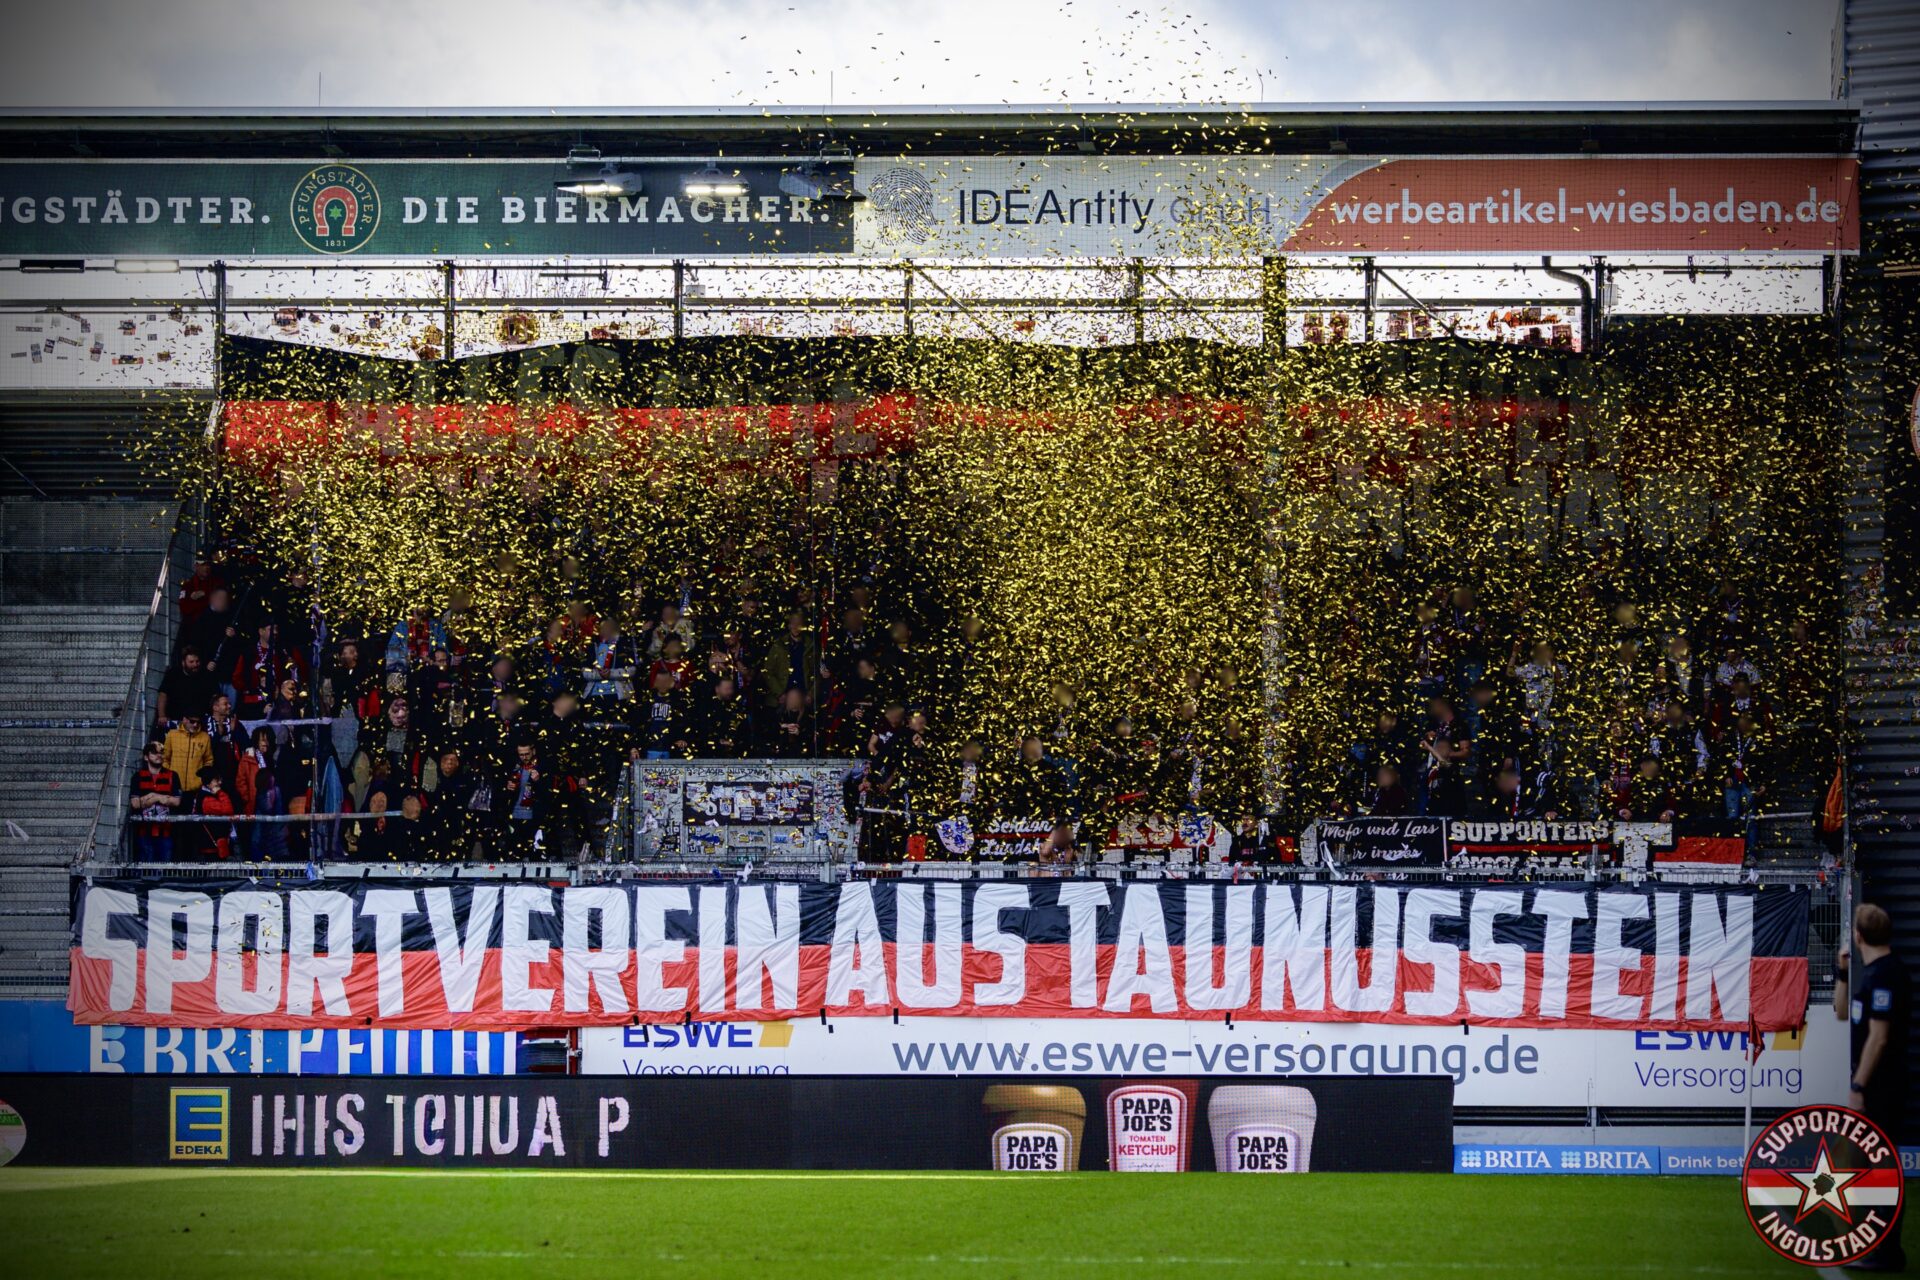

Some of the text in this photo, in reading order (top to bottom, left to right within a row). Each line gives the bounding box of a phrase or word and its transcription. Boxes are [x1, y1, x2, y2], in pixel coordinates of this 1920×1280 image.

[0, 190, 271, 224] GSTÄDTER.
[298, 172, 373, 224] PFUNGSTÄDTER
[1334, 187, 1840, 224] werbeartikel-wiesbaden.de
[402, 196, 831, 224] DIE BIERMACHER.
[959, 189, 1270, 233] IDEAntity GmbH
[325, 240, 346, 248] 1831
[1366, 822, 1400, 836] und
[1403, 821, 1439, 837] Lars
[1451, 820, 1609, 842] SUPPORTERS
[82, 882, 1754, 1022] SPORTVEREIN AUS TAUNUSSTEIN
[892, 1034, 1539, 1085] www.eswe-versorgung.de
[1634, 1061, 1803, 1094] Versorgung
[1122, 1098, 1173, 1115] PAPA
[1122, 1115, 1172, 1132] JOE'S
[1007, 1136, 1058, 1153] PAPA
[1129, 1135, 1166, 1143] TOMATEN
[1237, 1136, 1288, 1153] PAPA
[175, 1145, 223, 1155] EDEKA
[1118, 1145, 1177, 1156] KETCHUP
[1007, 1153, 1057, 1170] JOE'S
[1238, 1152, 1288, 1170] JOE'S
[1484, 1150, 1552, 1169] BRITA
[1584, 1151, 1652, 1169] BRITA
[1668, 1155, 1713, 1168] Drink
